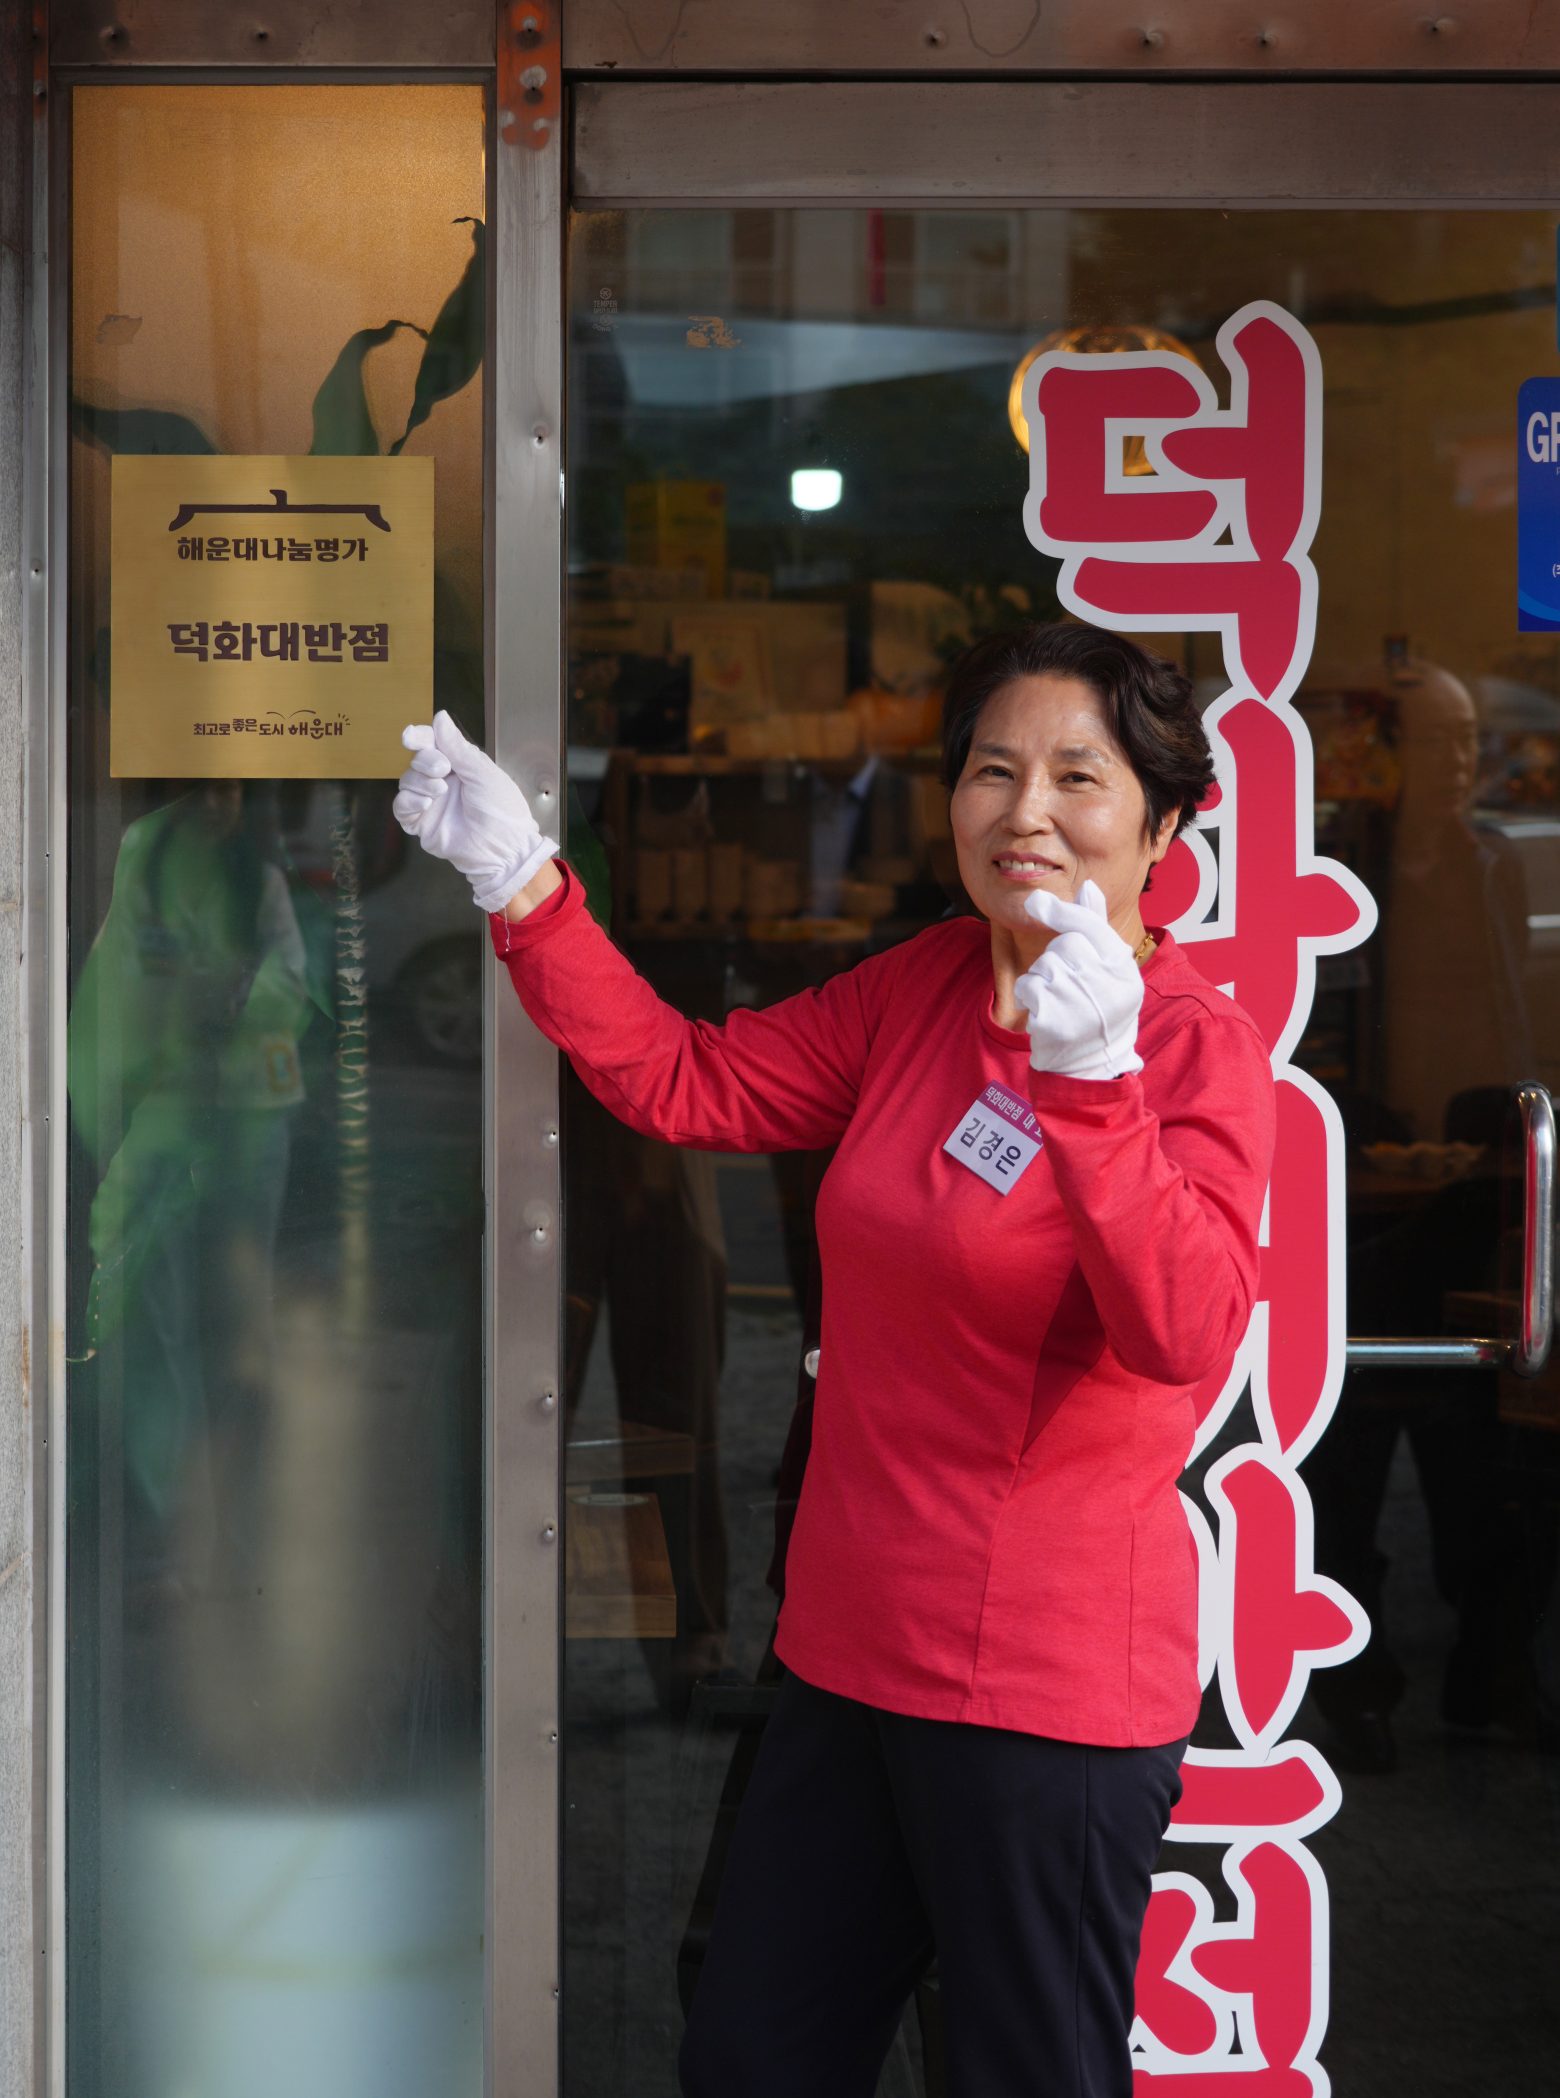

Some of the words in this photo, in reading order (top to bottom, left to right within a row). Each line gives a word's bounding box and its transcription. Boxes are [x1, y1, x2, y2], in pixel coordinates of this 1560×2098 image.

[177, 537, 369, 562] 해운대나눔명가
[167, 621, 389, 662] 덕화대반점
[193, 723, 231, 736] 최고로
[232, 718, 258, 732] 좋은
[258, 723, 284, 736] 도시
[288, 718, 343, 740] 해운대
[985, 1086, 1025, 1121] 덕화대반점
[959, 1117, 1022, 1176] 김경은
